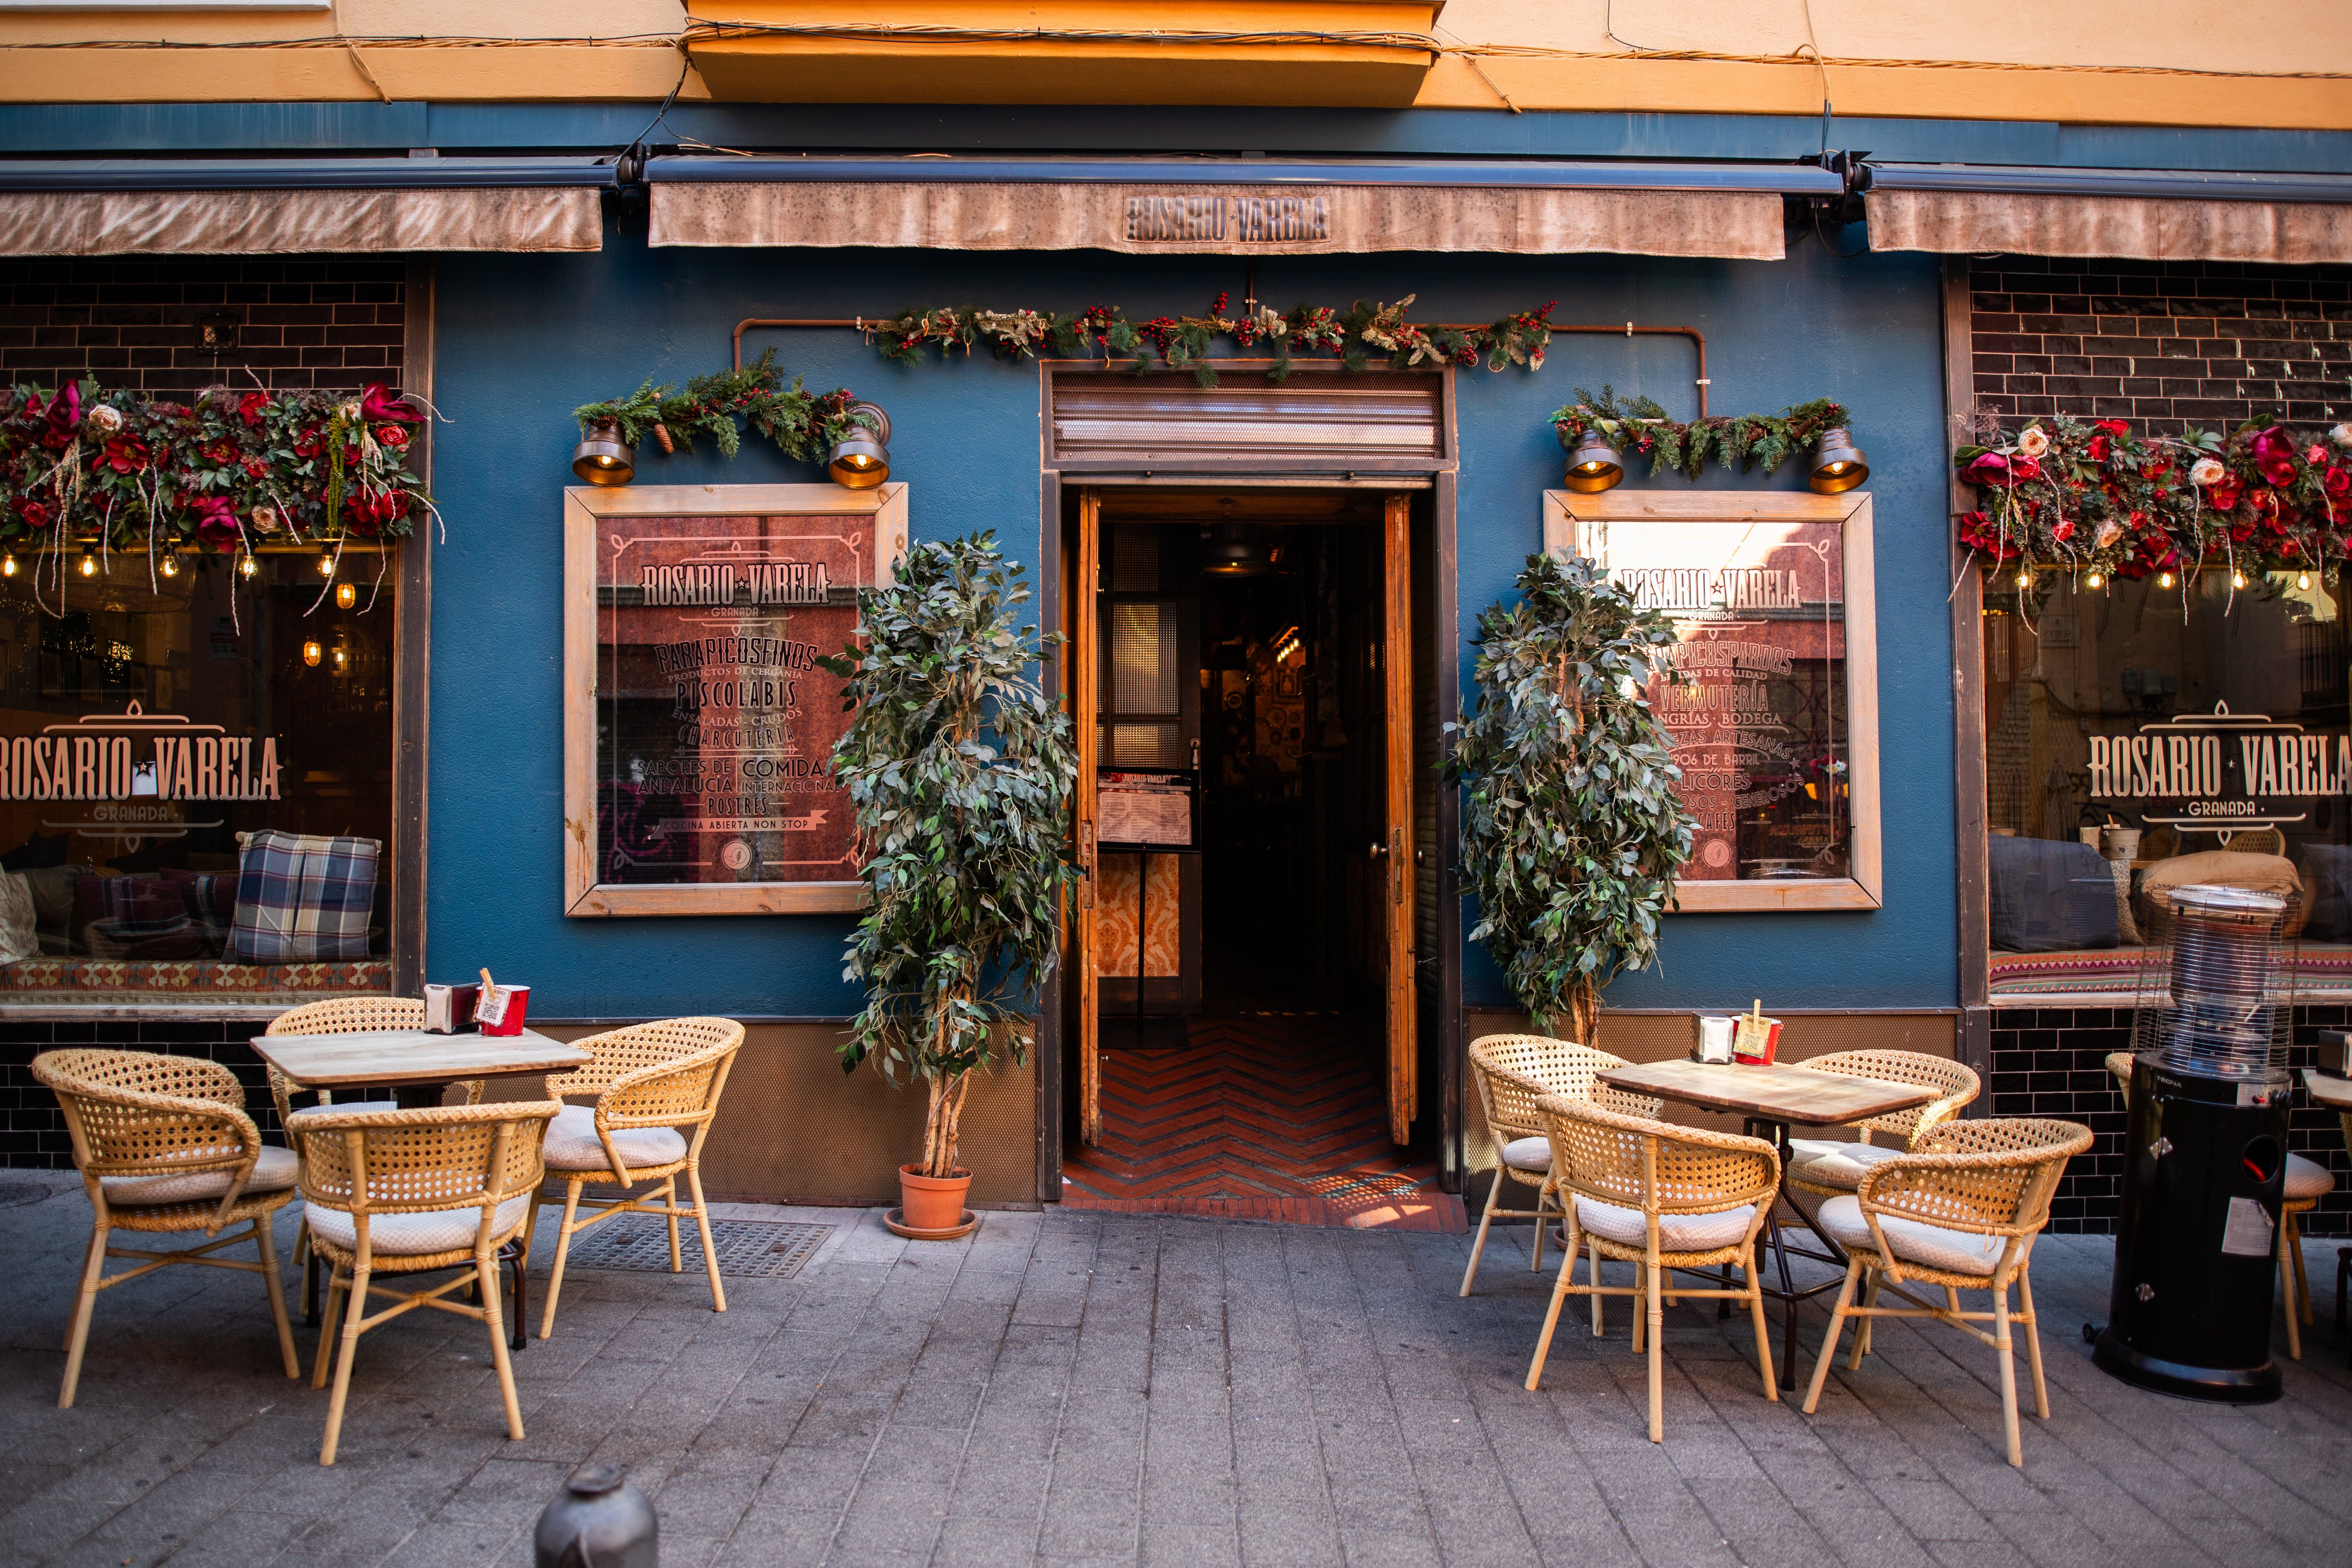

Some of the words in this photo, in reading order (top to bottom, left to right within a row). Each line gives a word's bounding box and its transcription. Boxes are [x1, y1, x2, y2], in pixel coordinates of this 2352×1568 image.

[1127, 196, 1227, 241] ROSARIO
[1235, 196, 1328, 241] VARELA
[641, 565, 735, 606] ROSARIO
[747, 562, 832, 606] VARELA
[1722, 569, 1802, 609] VARELA
[711, 607, 758, 616] GRANADA
[1688, 611, 1734, 621] GRANADA
[655, 636, 819, 674] PARAPICOSFINOS
[668, 668, 730, 683] PRODUCTOS
[751, 667, 804, 680] CERCANÍA
[1705, 669, 1719, 677] DE
[1722, 669, 1768, 681] CALIDAD
[676, 680, 797, 709] PISCOLABIS
[1659, 680, 1769, 711] VERMUTERÍA
[671, 709, 739, 727] ENSALADAS
[752, 707, 803, 726] CRUDOS
[1722, 713, 1783, 725] BODEGA
[678, 723, 796, 748] CHARCUTERÍA
[1713, 729, 1793, 760] ARTESANAS
[154, 736, 284, 800] VARELA
[637, 760, 706, 775] SABORES
[712, 760, 731, 774] DE
[742, 758, 824, 778] COMIDA
[1702, 754, 1718, 766] DE
[1724, 753, 1760, 766] BARRIL
[2086, 736, 2221, 797] ROSARIO
[2240, 735, 2352, 796] VARELA
[1147, 774, 1166, 784] VARELA
[1680, 773, 1750, 791] LICORES
[1733, 772, 1805, 810] GENEROSOS
[94, 806, 168, 821] GRANADA
[707, 796, 767, 815] POSTRES
[2188, 801, 2256, 816] GRANADA
[664, 820, 704, 830] COCINA
[710, 820, 748, 830] ABIERTA
[754, 820, 776, 829] NON
[782, 820, 808, 828] STOP
[1696, 808, 1736, 832] CAFÉS
